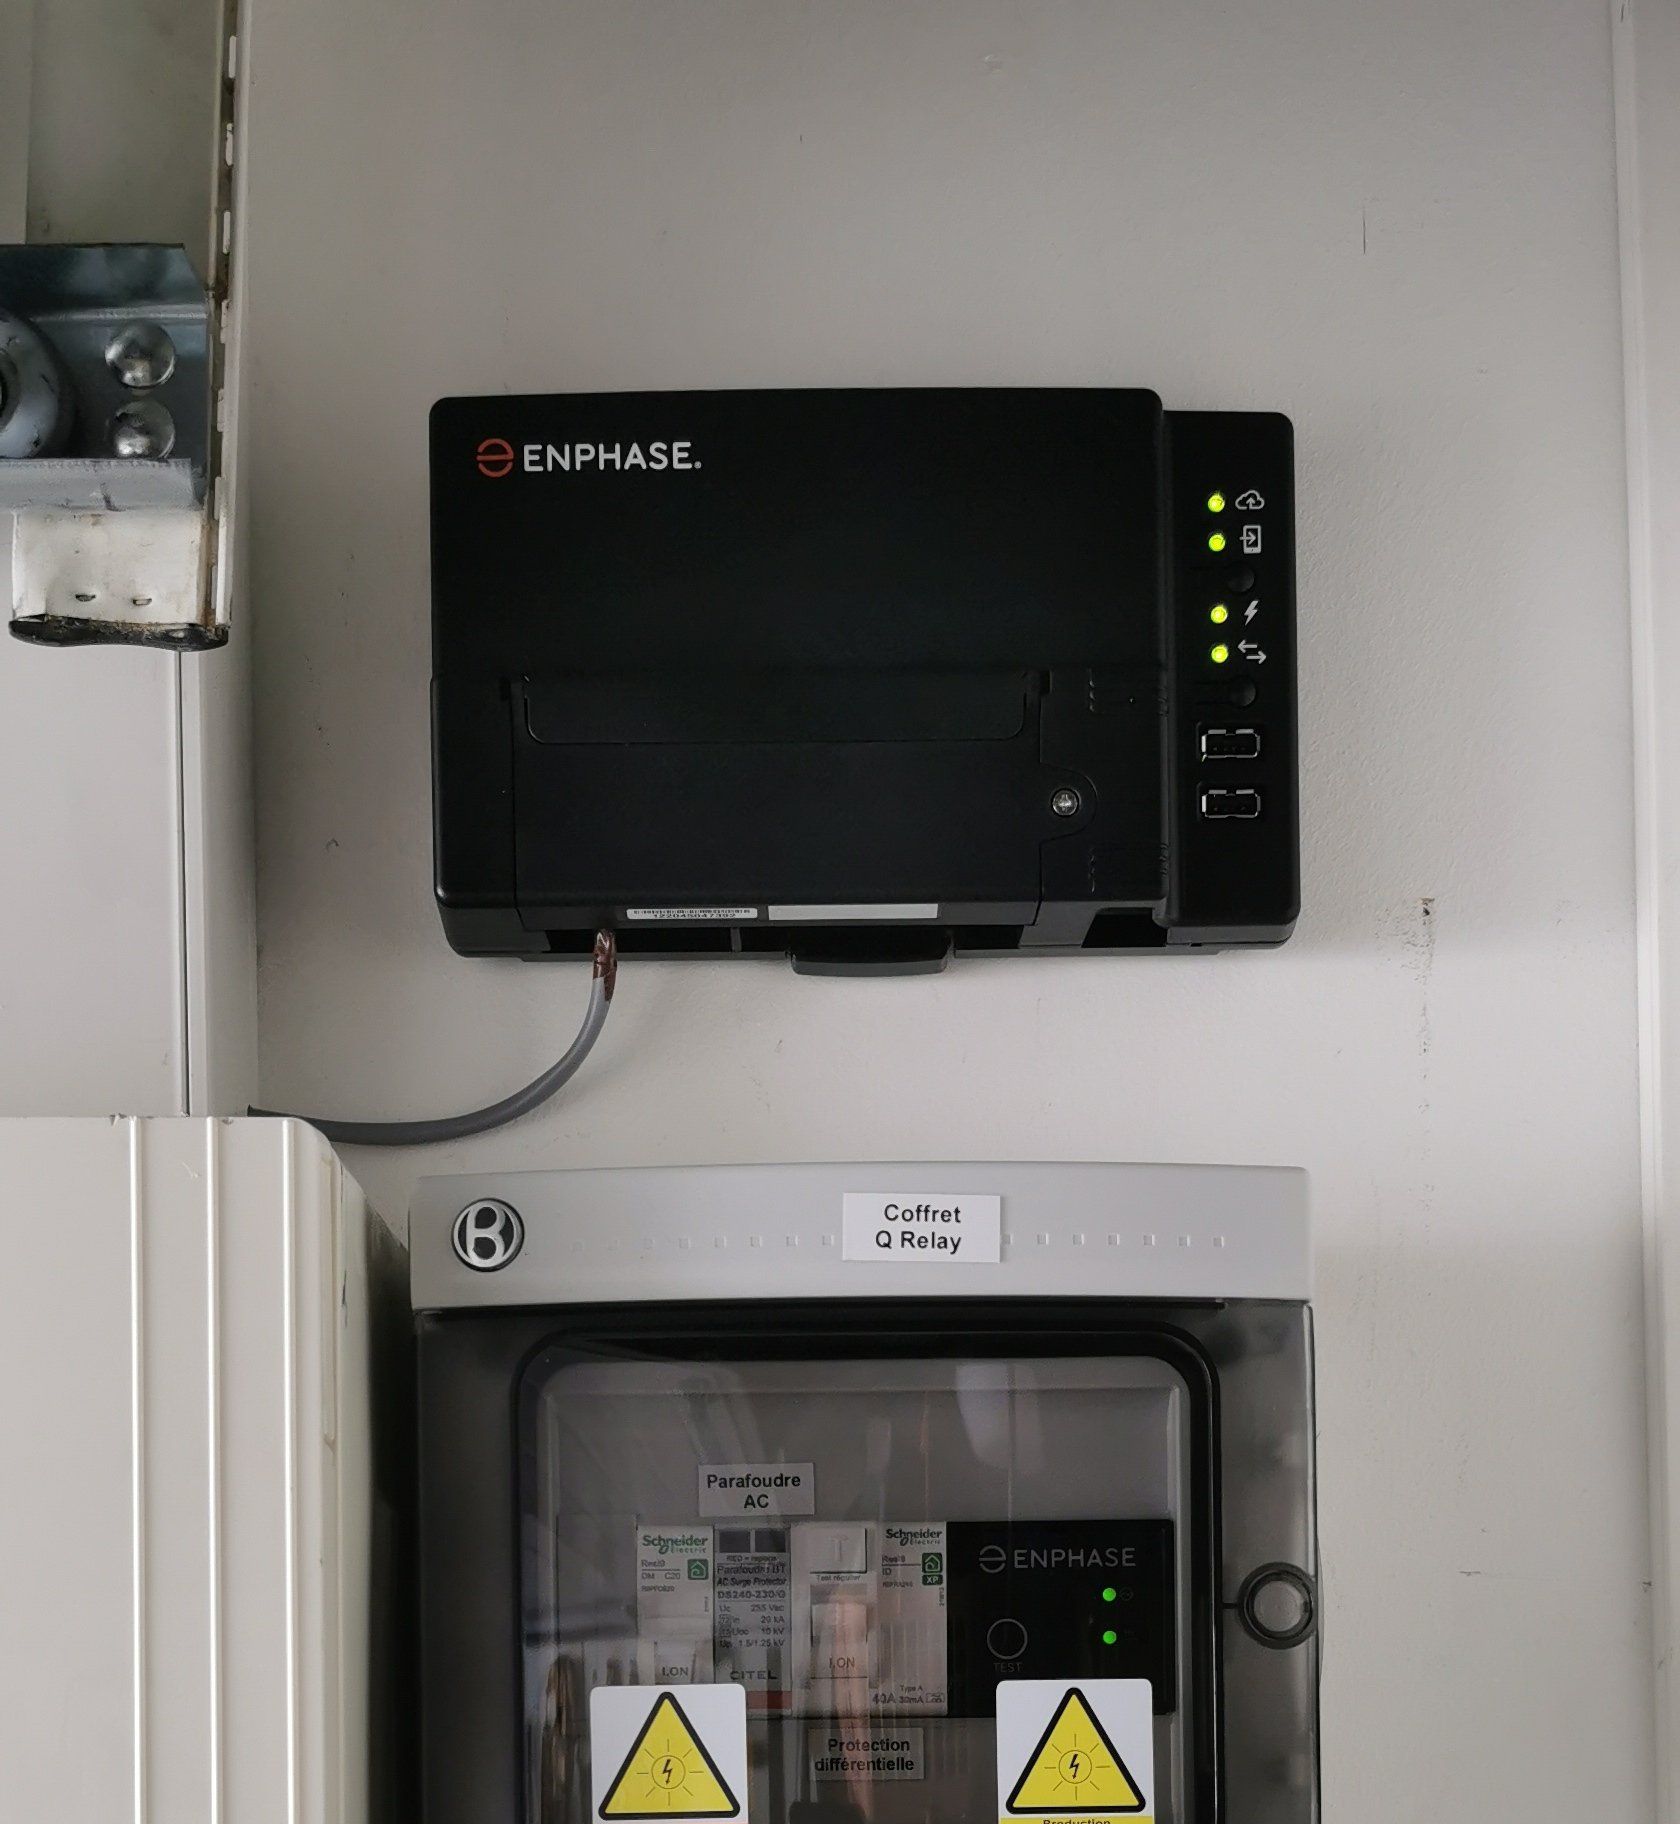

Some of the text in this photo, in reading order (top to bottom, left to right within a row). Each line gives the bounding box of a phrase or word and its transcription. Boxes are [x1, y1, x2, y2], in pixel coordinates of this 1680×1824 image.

[884, 1203, 961, 1223] Coffret
[875, 1230, 961, 1255] Q Relay
[707, 1473, 801, 1488] Parafoudre
[744, 1494, 769, 1508] AC
[642, 1534, 708, 1554] Schneider
[886, 1528, 942, 1546] Schneider
[1014, 1548, 1136, 1569] ENPHASE
[926, 1576, 939, 1584] XP
[993, 1661, 1023, 1672] TEST
[730, 1670, 778, 1680] CITEL
[828, 1738, 910, 1751] Protection
[815, 1757, 914, 1771] différentielle
